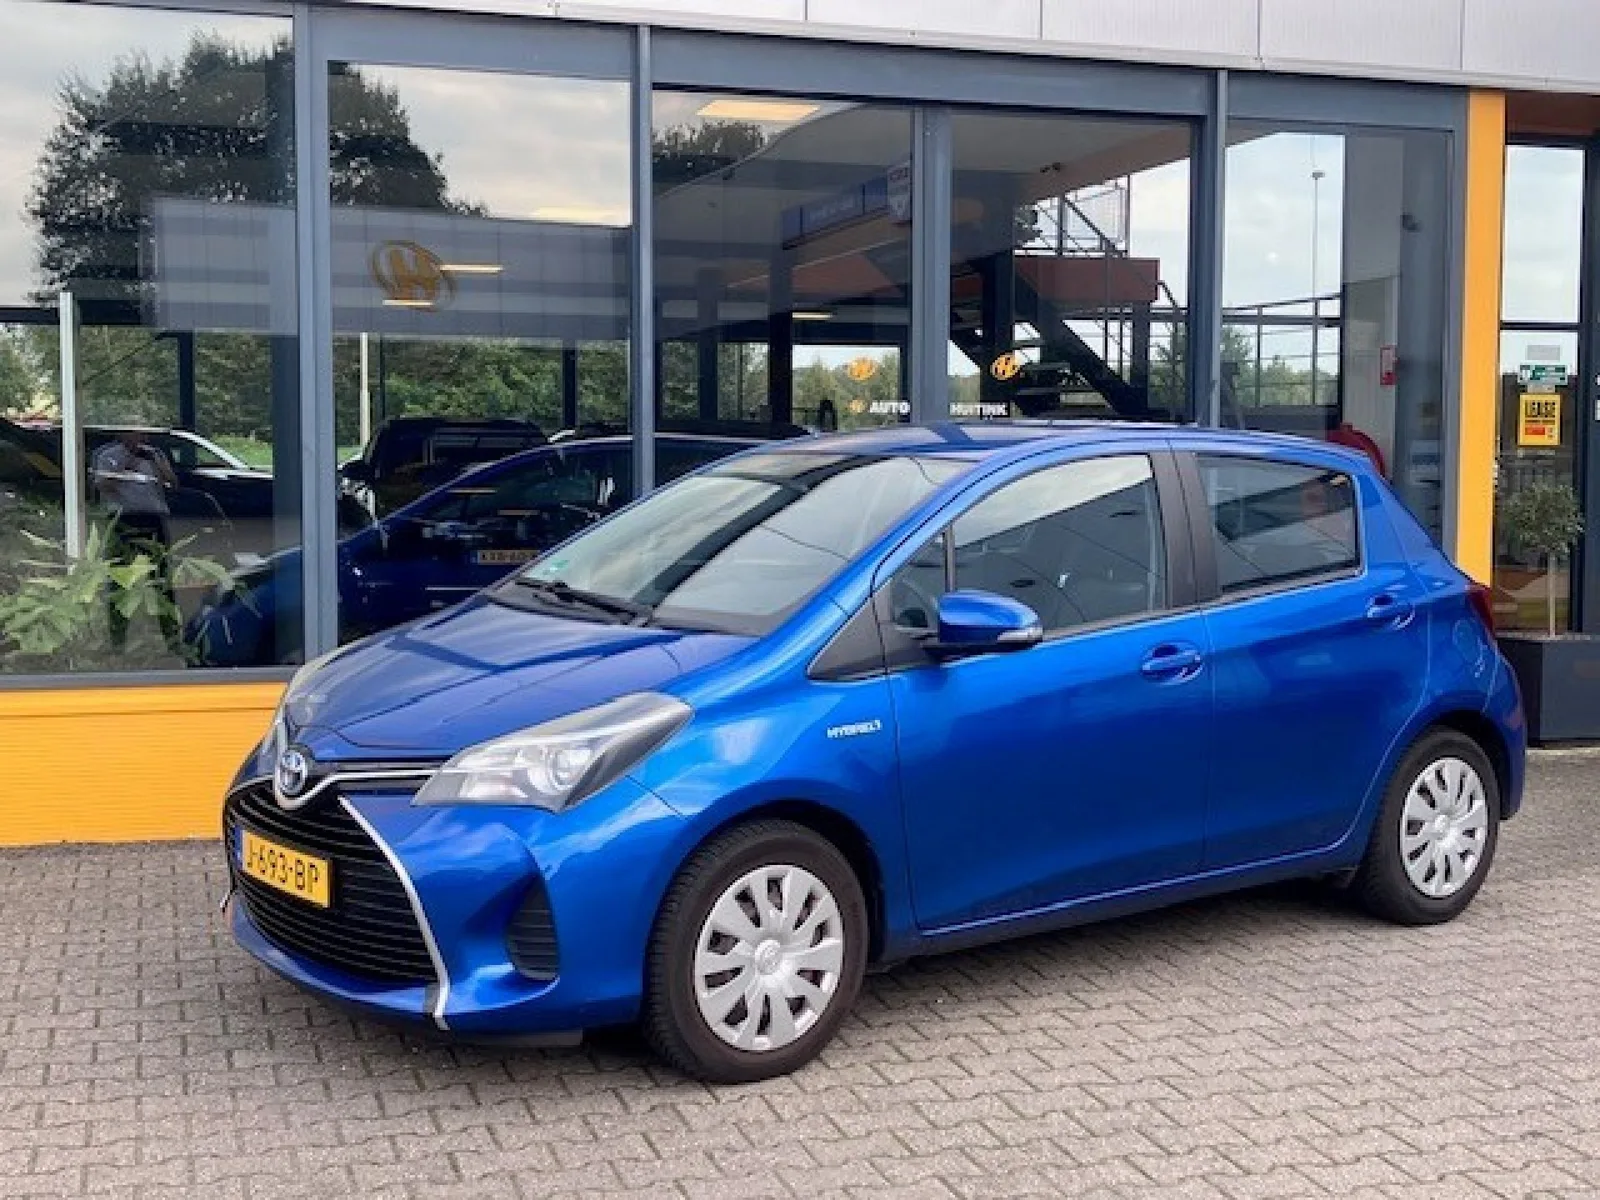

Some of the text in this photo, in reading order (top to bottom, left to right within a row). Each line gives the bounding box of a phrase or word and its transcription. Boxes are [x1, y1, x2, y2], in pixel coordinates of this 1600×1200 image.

[868, 402, 911, 414] AUTO
[1524, 400, 1556, 418] LEASE
[246, 838, 320, 894] J-693-BP
